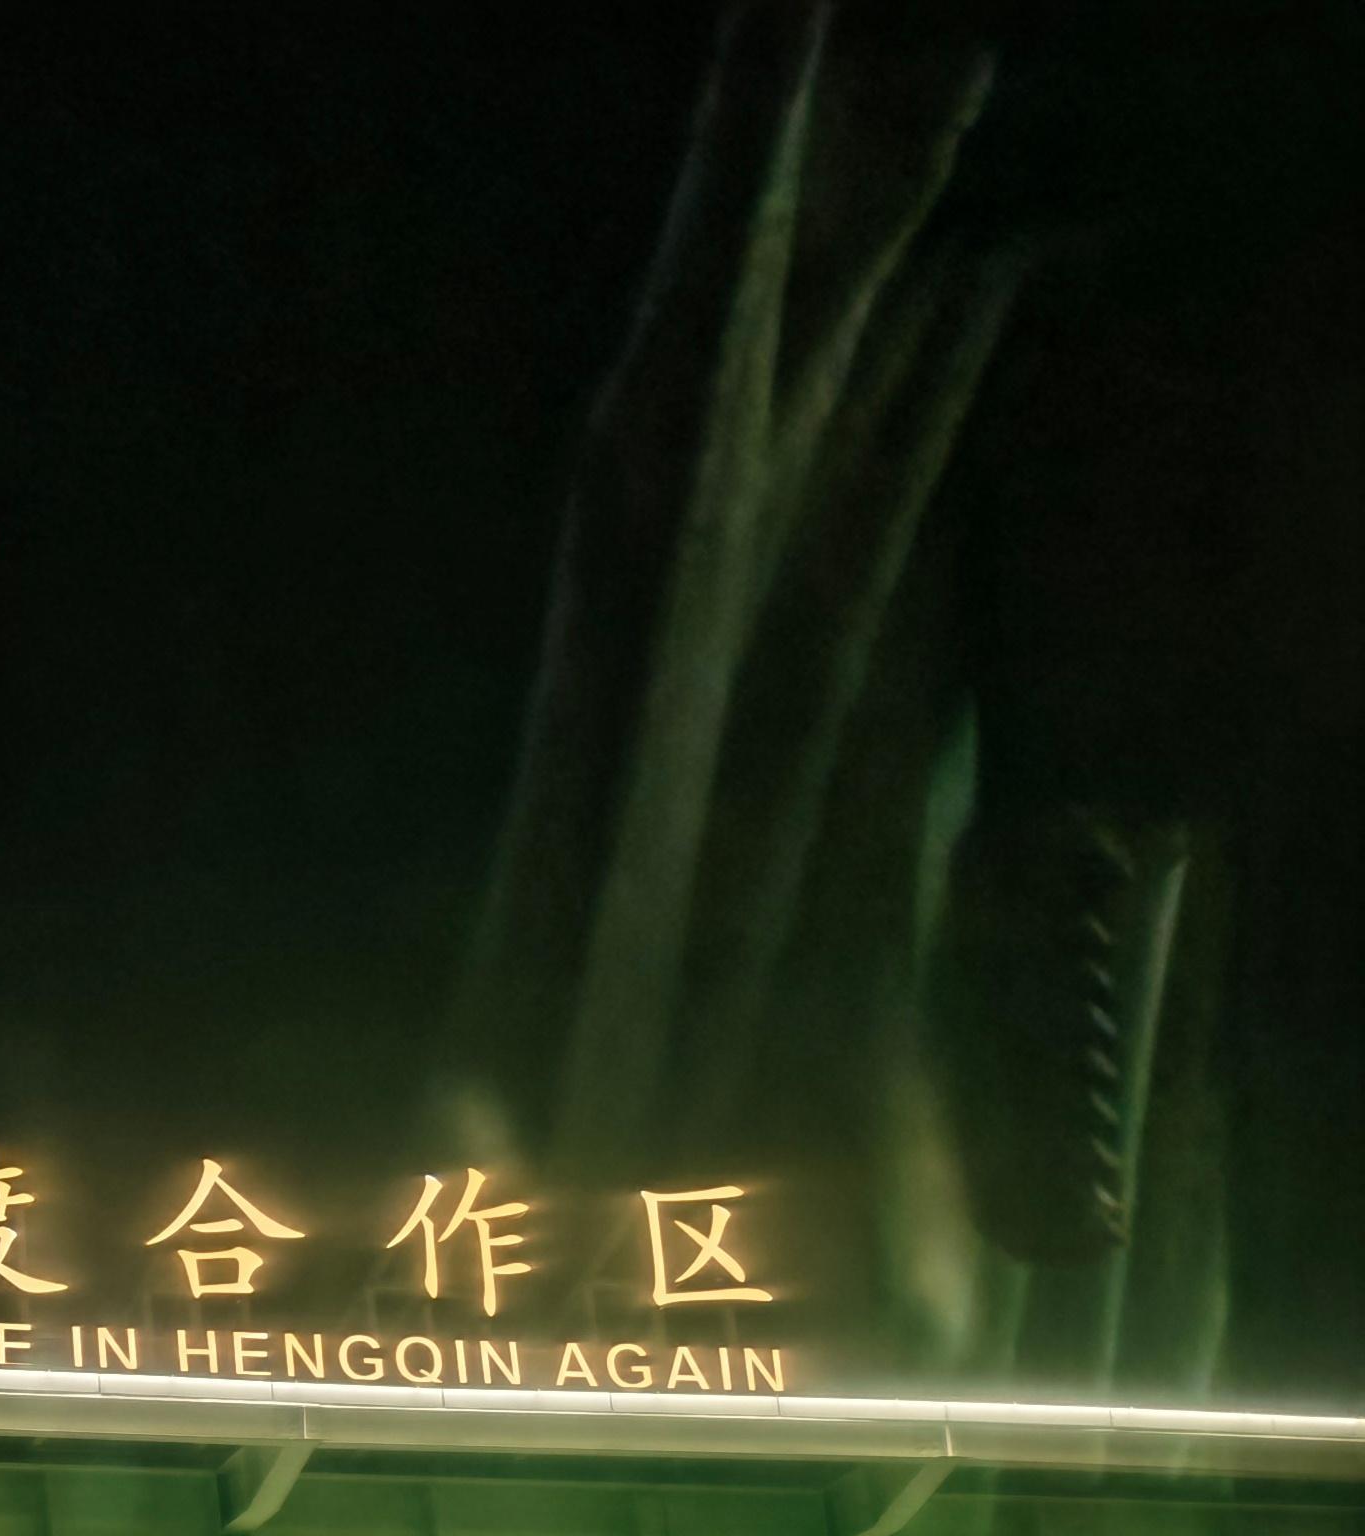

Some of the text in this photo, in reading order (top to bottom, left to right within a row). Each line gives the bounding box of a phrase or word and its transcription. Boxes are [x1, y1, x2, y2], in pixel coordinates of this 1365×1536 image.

[71, 1325, 139, 1370] IN
[176, 1329, 521, 1386] HENGQIN
[555, 1342, 786, 1392] AGAIN
